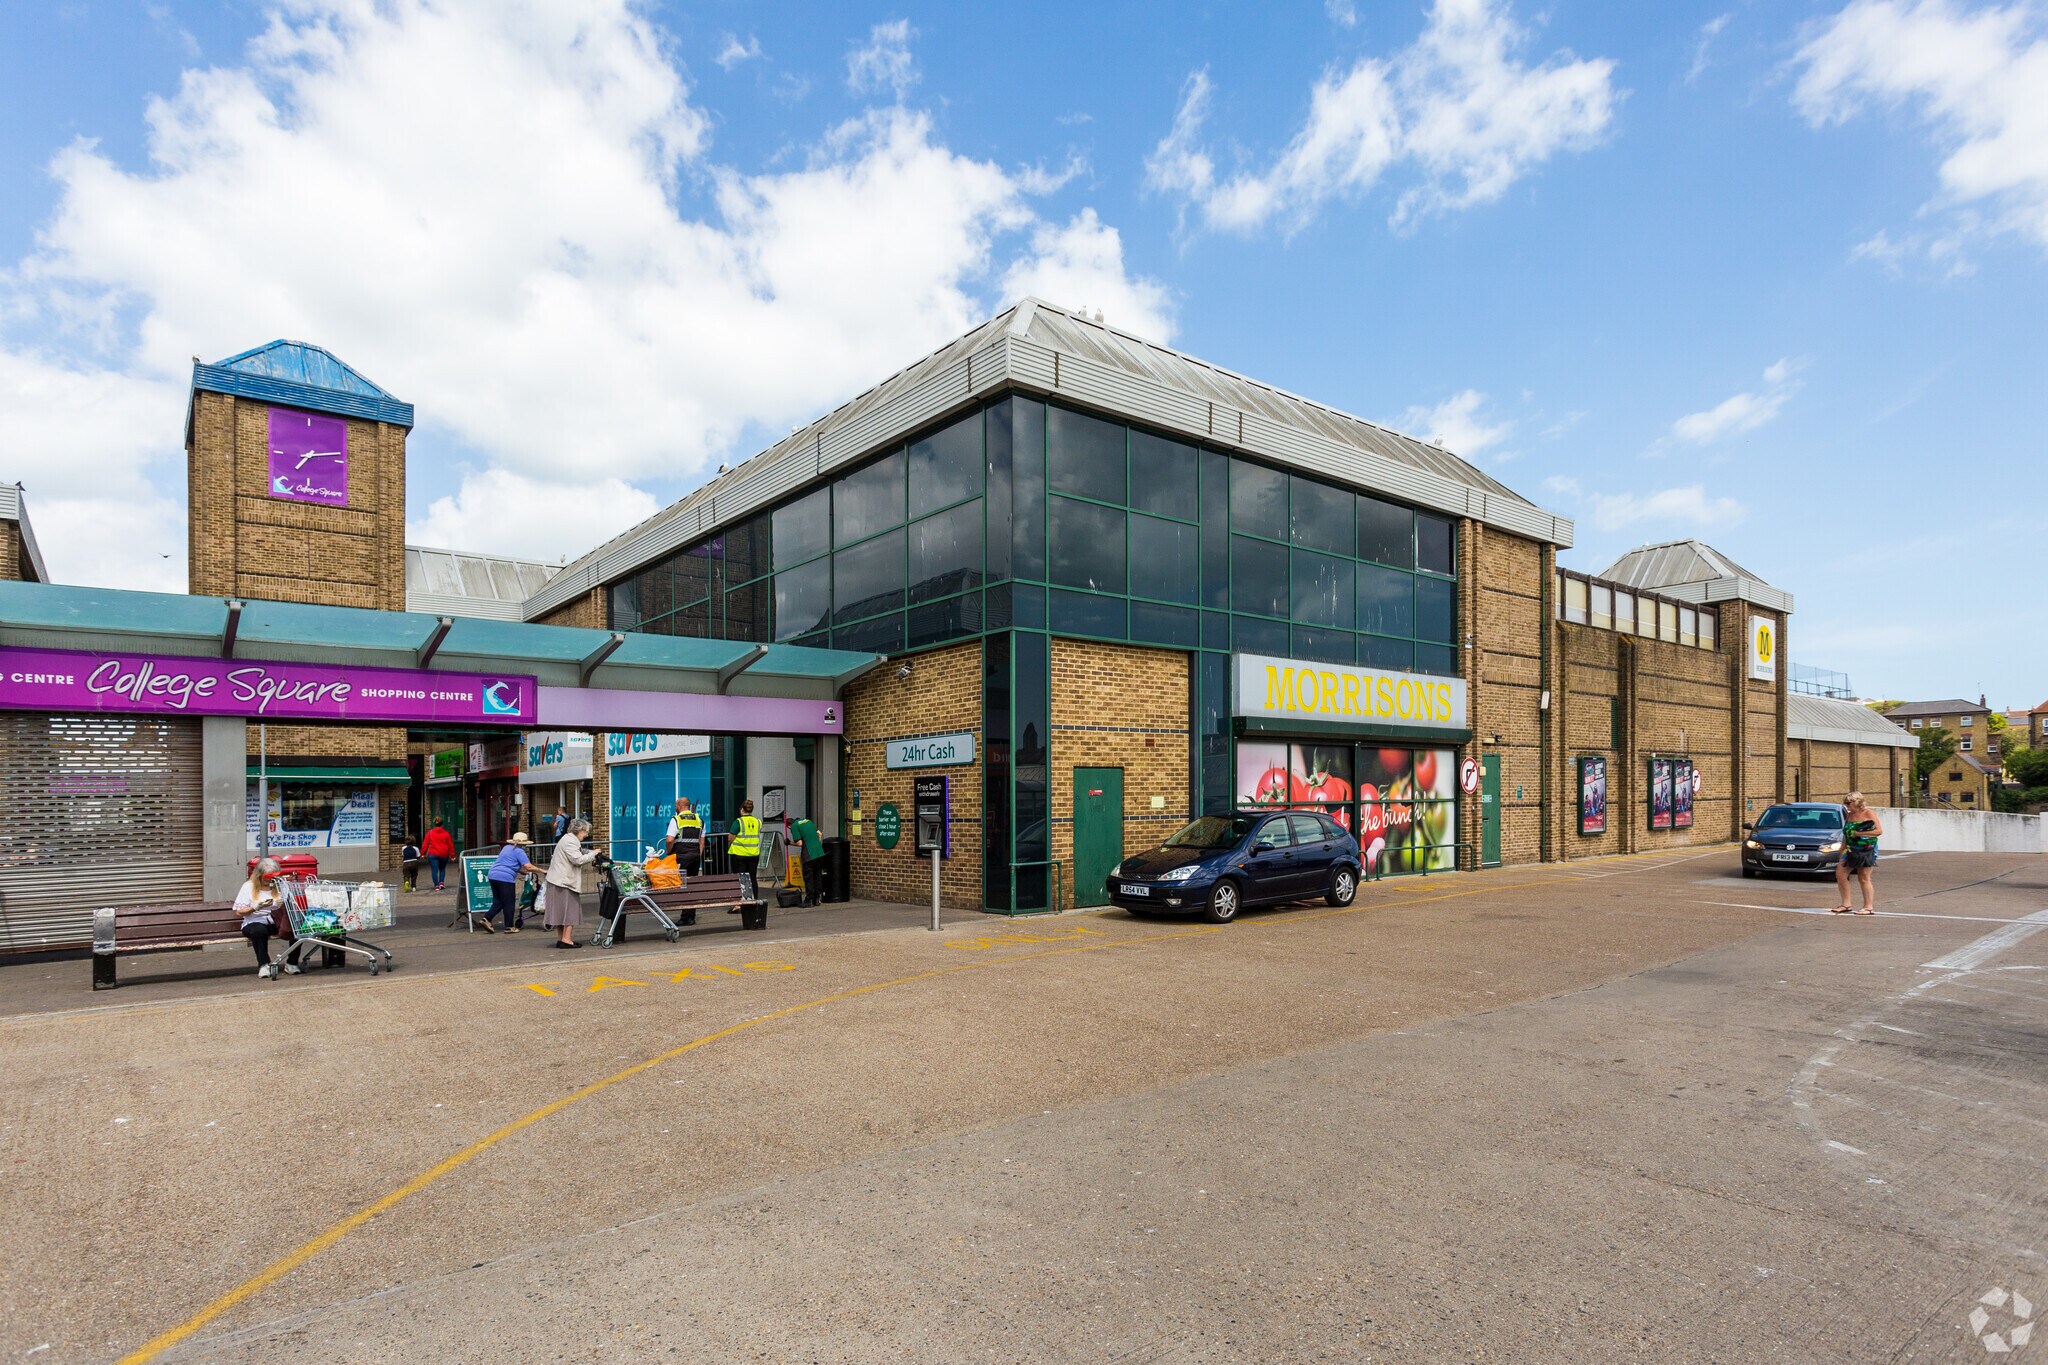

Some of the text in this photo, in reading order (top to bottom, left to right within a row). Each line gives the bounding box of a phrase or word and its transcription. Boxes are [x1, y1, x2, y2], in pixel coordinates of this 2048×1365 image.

[1760, 631, 1770, 656] M
[11, 672, 74, 686] CENTRE
[85, 659, 219, 709] College
[226, 666, 352, 714] Square
[360, 687, 426, 700] SHOPPING
[430, 690, 473, 702] CENTRE
[1263, 664, 1452, 722] MORRISONS
[528, 735, 563, 767] savers
[608, 732, 657, 756] savers
[902, 741, 955, 762] 24hr Cash
[352, 792, 374, 800] Meal
[917, 782, 942, 791] Free Cash
[351, 800, 375, 808] Deals
[614, 801, 637, 817] savers
[645, 800, 671, 817] savers
[1382, 790, 1427, 829] bunch!
[272, 840, 296, 848] Snack
[297, 833, 317, 842] Shop
[500, 960, 796, 997] TAXIS
